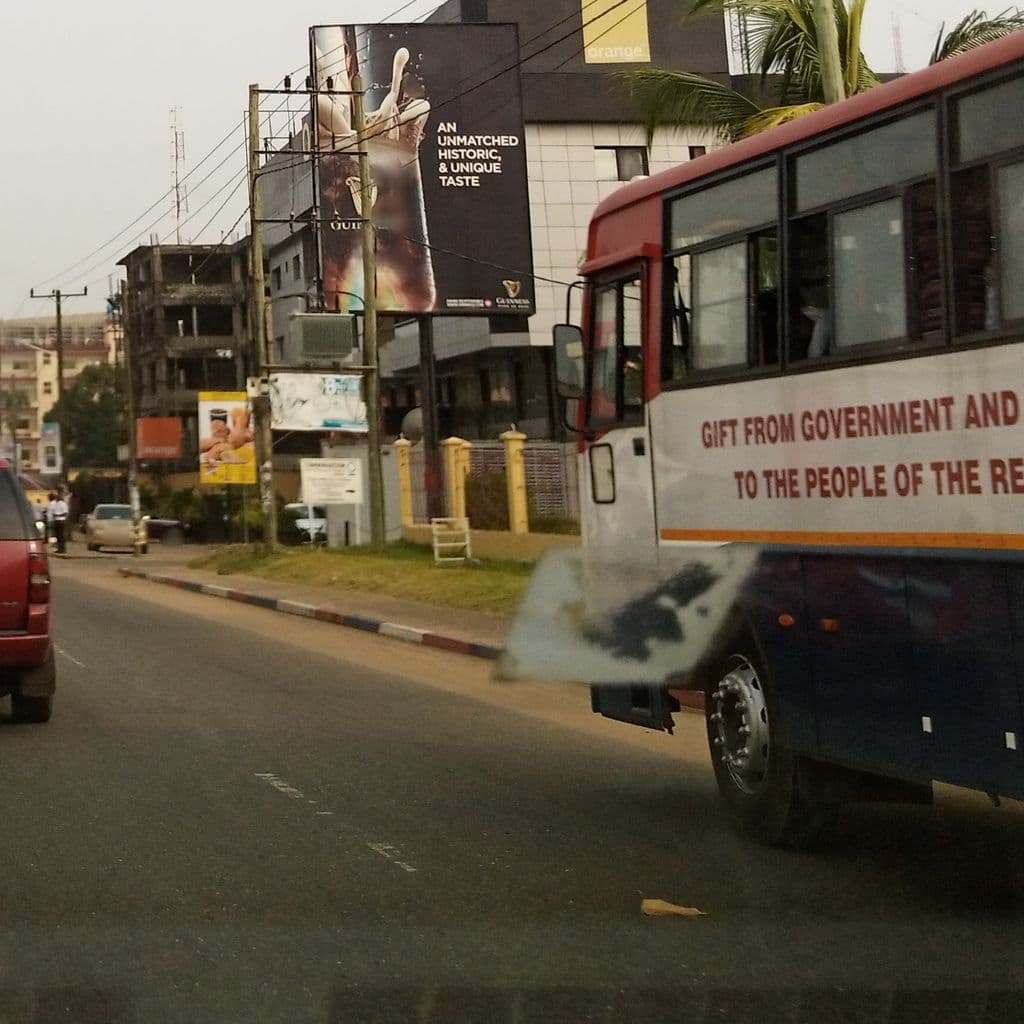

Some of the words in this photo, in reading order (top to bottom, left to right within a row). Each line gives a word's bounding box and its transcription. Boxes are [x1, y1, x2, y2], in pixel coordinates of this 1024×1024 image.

[587, 47, 643, 61] orange
[437, 122, 457, 133] AN
[437, 135, 519, 146] UNMATCHED
[438, 149, 502, 161] HISTORIC,
[438, 162, 448, 173] &
[450, 162, 502, 173] UNIQUE
[439, 176, 480, 187] TASTE
[701, 418, 738, 449] GIFT
[744, 412, 796, 446] FROM
[801, 396, 954, 441] GOVERNMENT
[965, 390, 1020, 429] AND
[734, 470, 758, 499] TO
[762, 468, 801, 499] THE
[805, 465, 887, 498] PEOPLE
[894, 463, 923, 497] OF
[930, 459, 982, 496] THE
[988, 457, 1024, 495] RE
